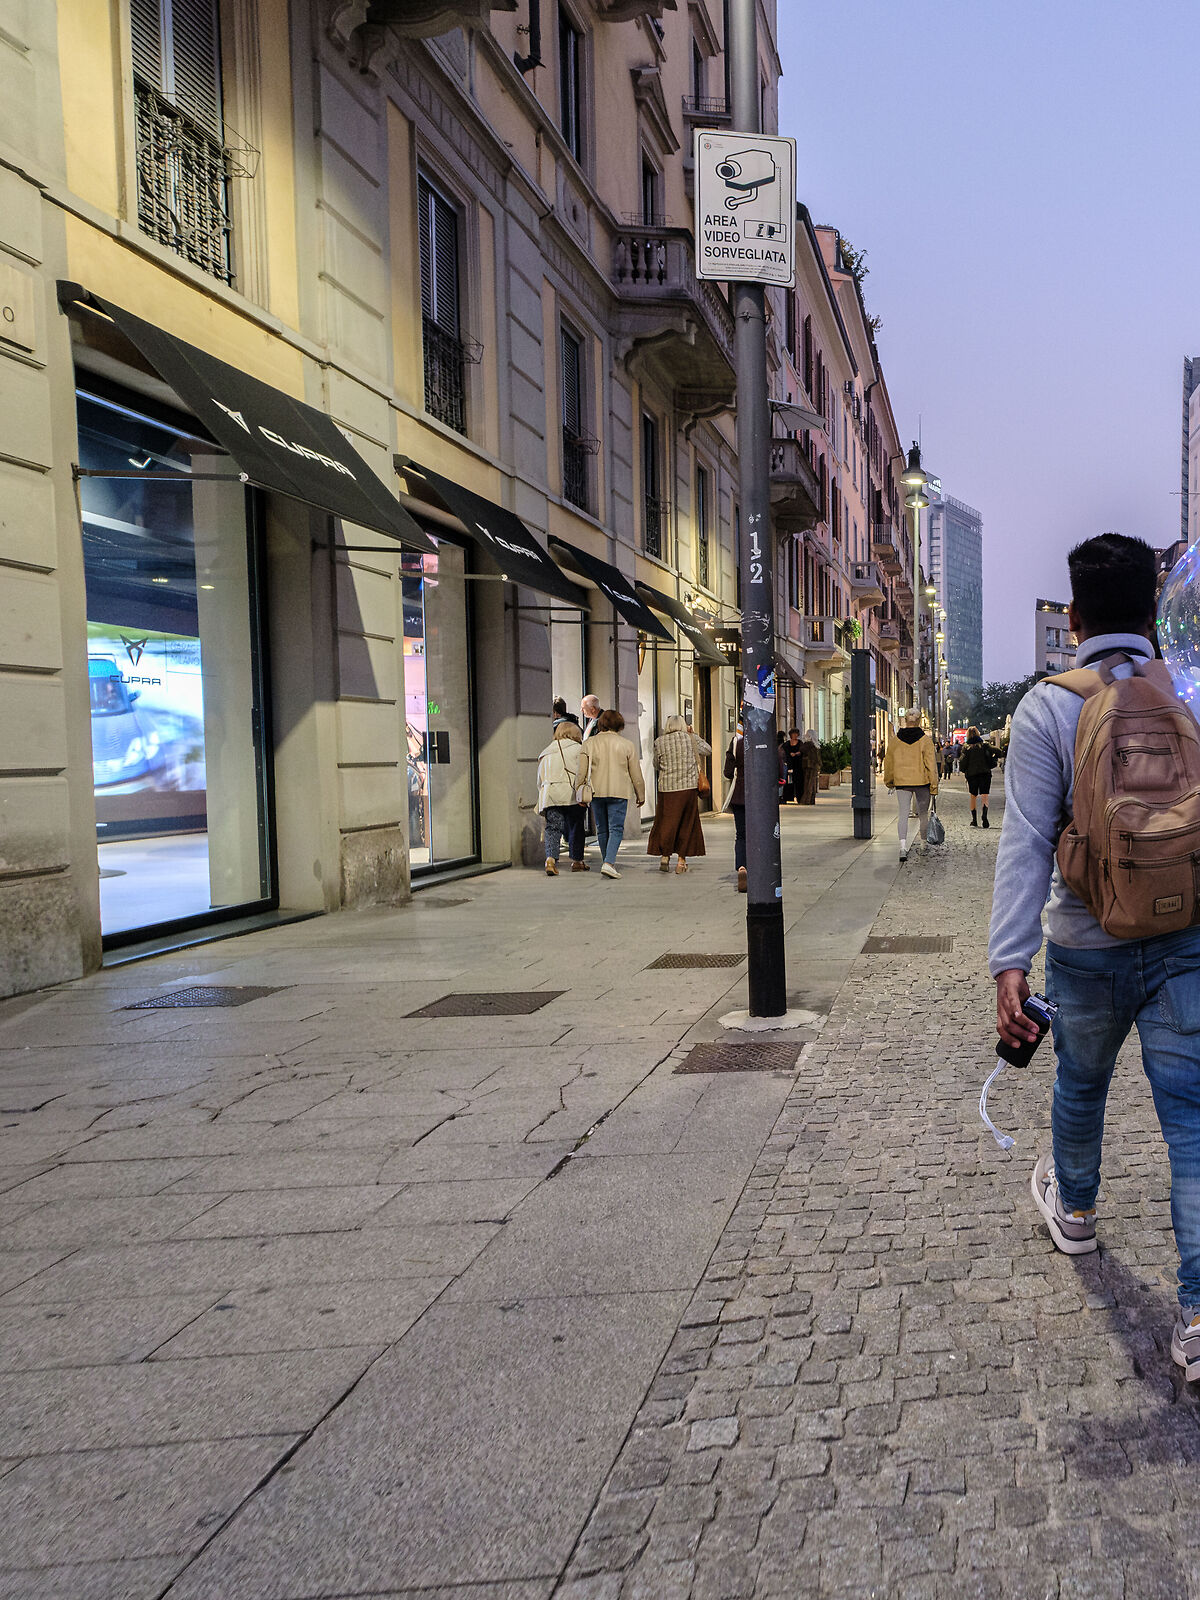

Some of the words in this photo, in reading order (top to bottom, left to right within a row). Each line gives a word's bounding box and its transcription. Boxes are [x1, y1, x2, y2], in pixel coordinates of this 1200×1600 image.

[704, 214, 738, 227] AREA
[704, 230, 741, 243] VIDEO
[704, 246, 787, 264] SORVEGLIATA
[258, 425, 357, 480] CUPRA
[109, 675, 162, 686] CUPRA
